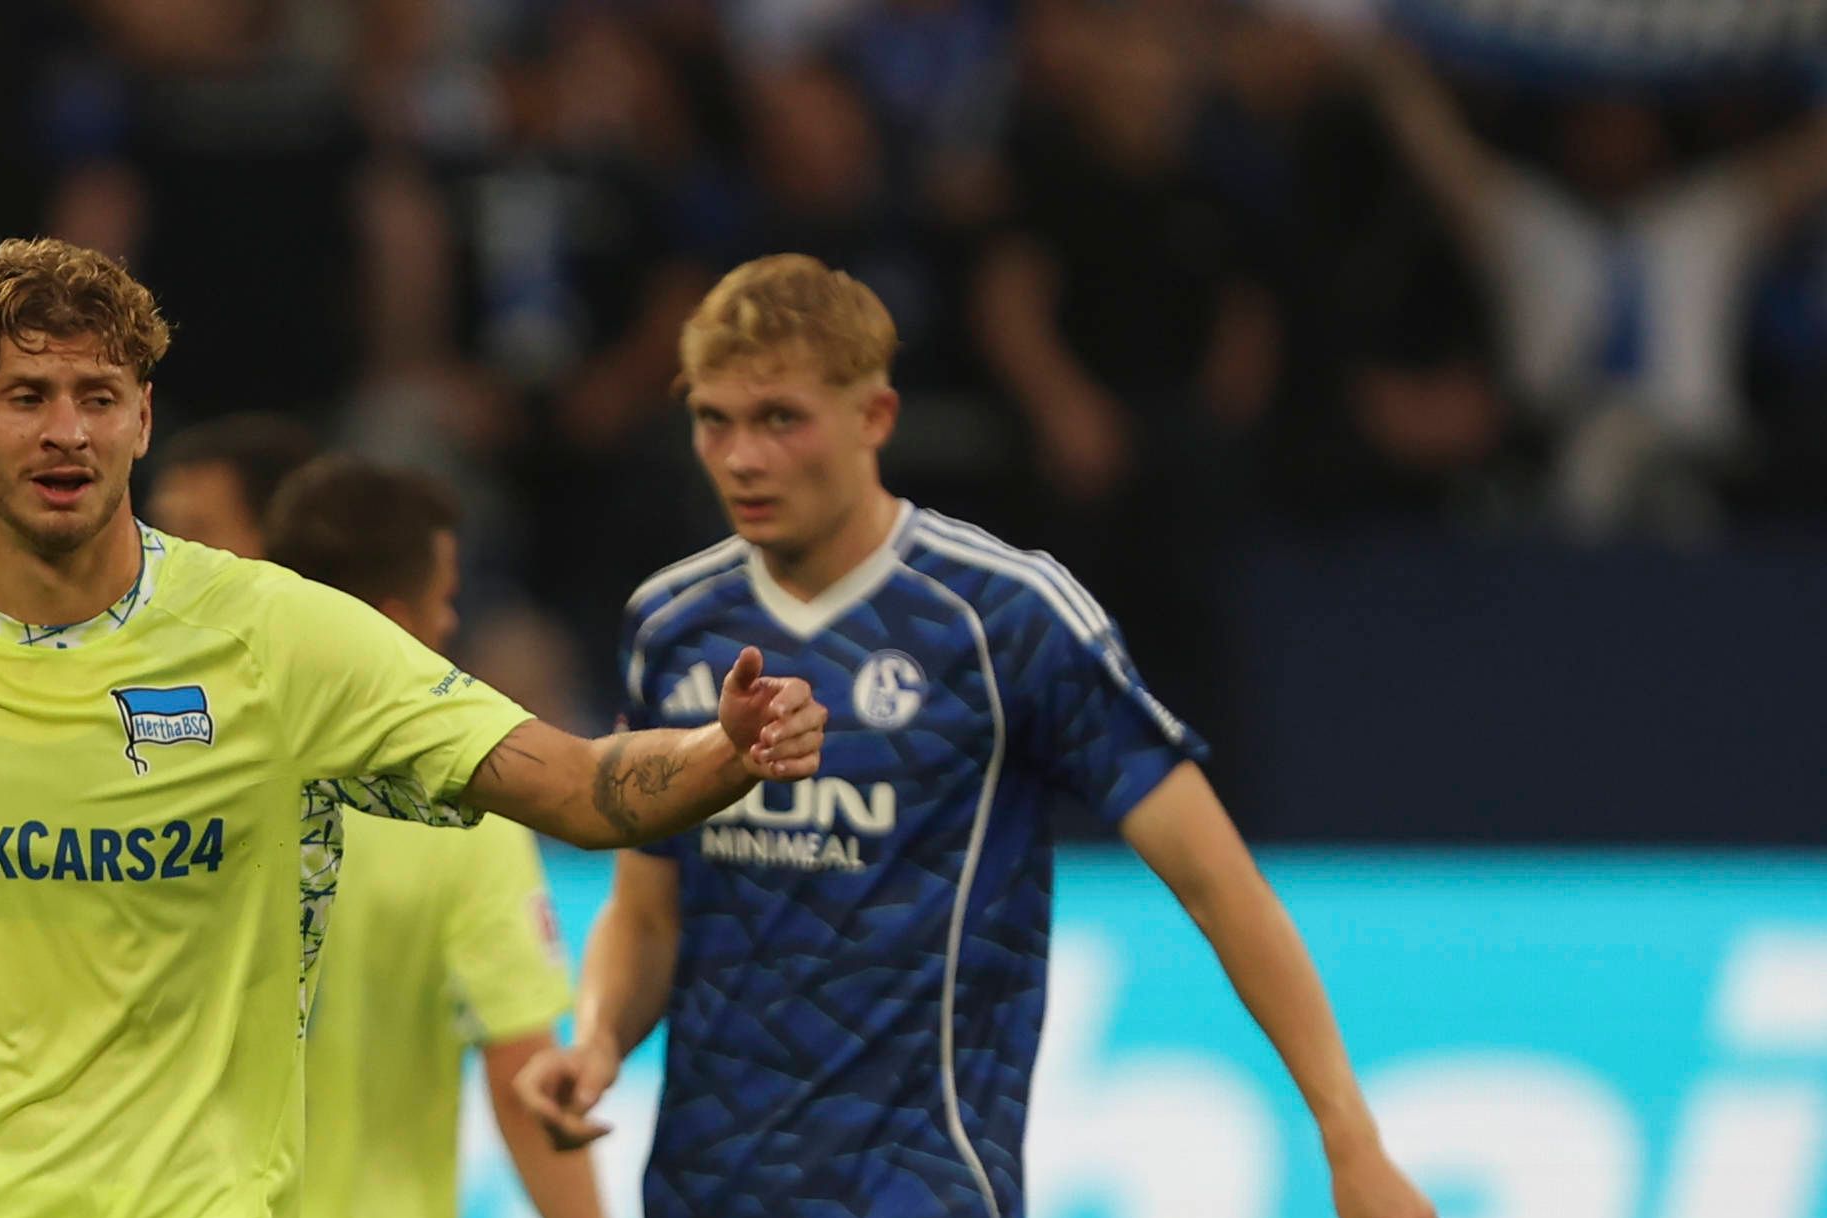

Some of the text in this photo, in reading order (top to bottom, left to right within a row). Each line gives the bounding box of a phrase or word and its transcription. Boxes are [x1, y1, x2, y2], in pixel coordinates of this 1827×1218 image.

[134, 715, 209, 740] Hertha BSC
[706, 776, 897, 835] UN
